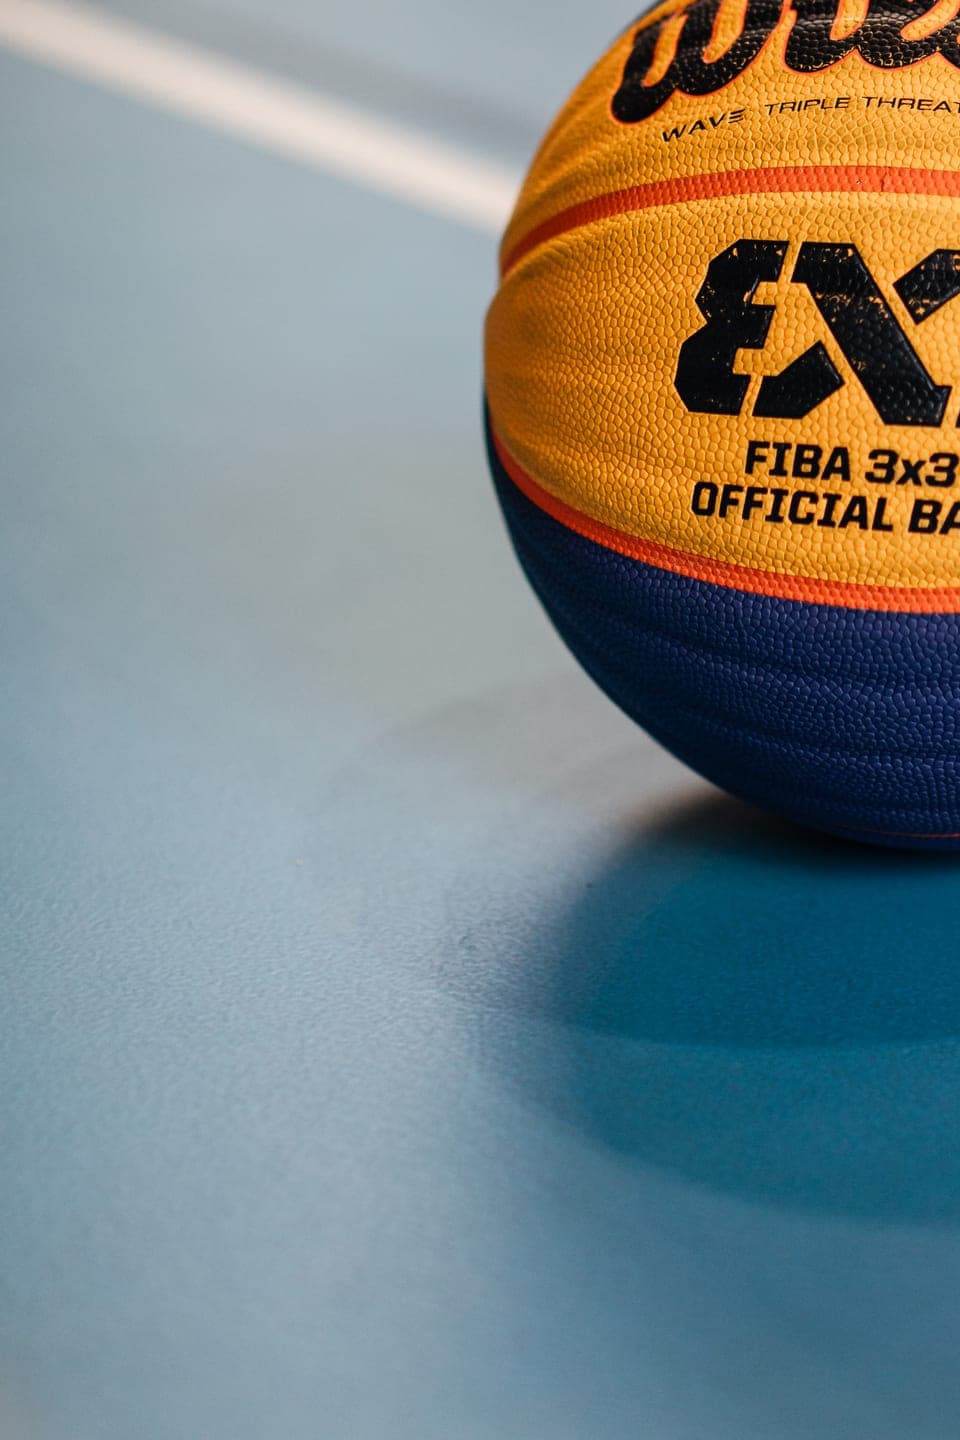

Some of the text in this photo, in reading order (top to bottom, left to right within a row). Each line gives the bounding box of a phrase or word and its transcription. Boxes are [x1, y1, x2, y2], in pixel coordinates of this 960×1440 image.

[661, 108, 746, 143] WAVE
[764, 97, 851, 116] TRIPLE
[745, 441, 960, 488] FIBA 3x3
[691, 481, 894, 532] OFFICIAL
